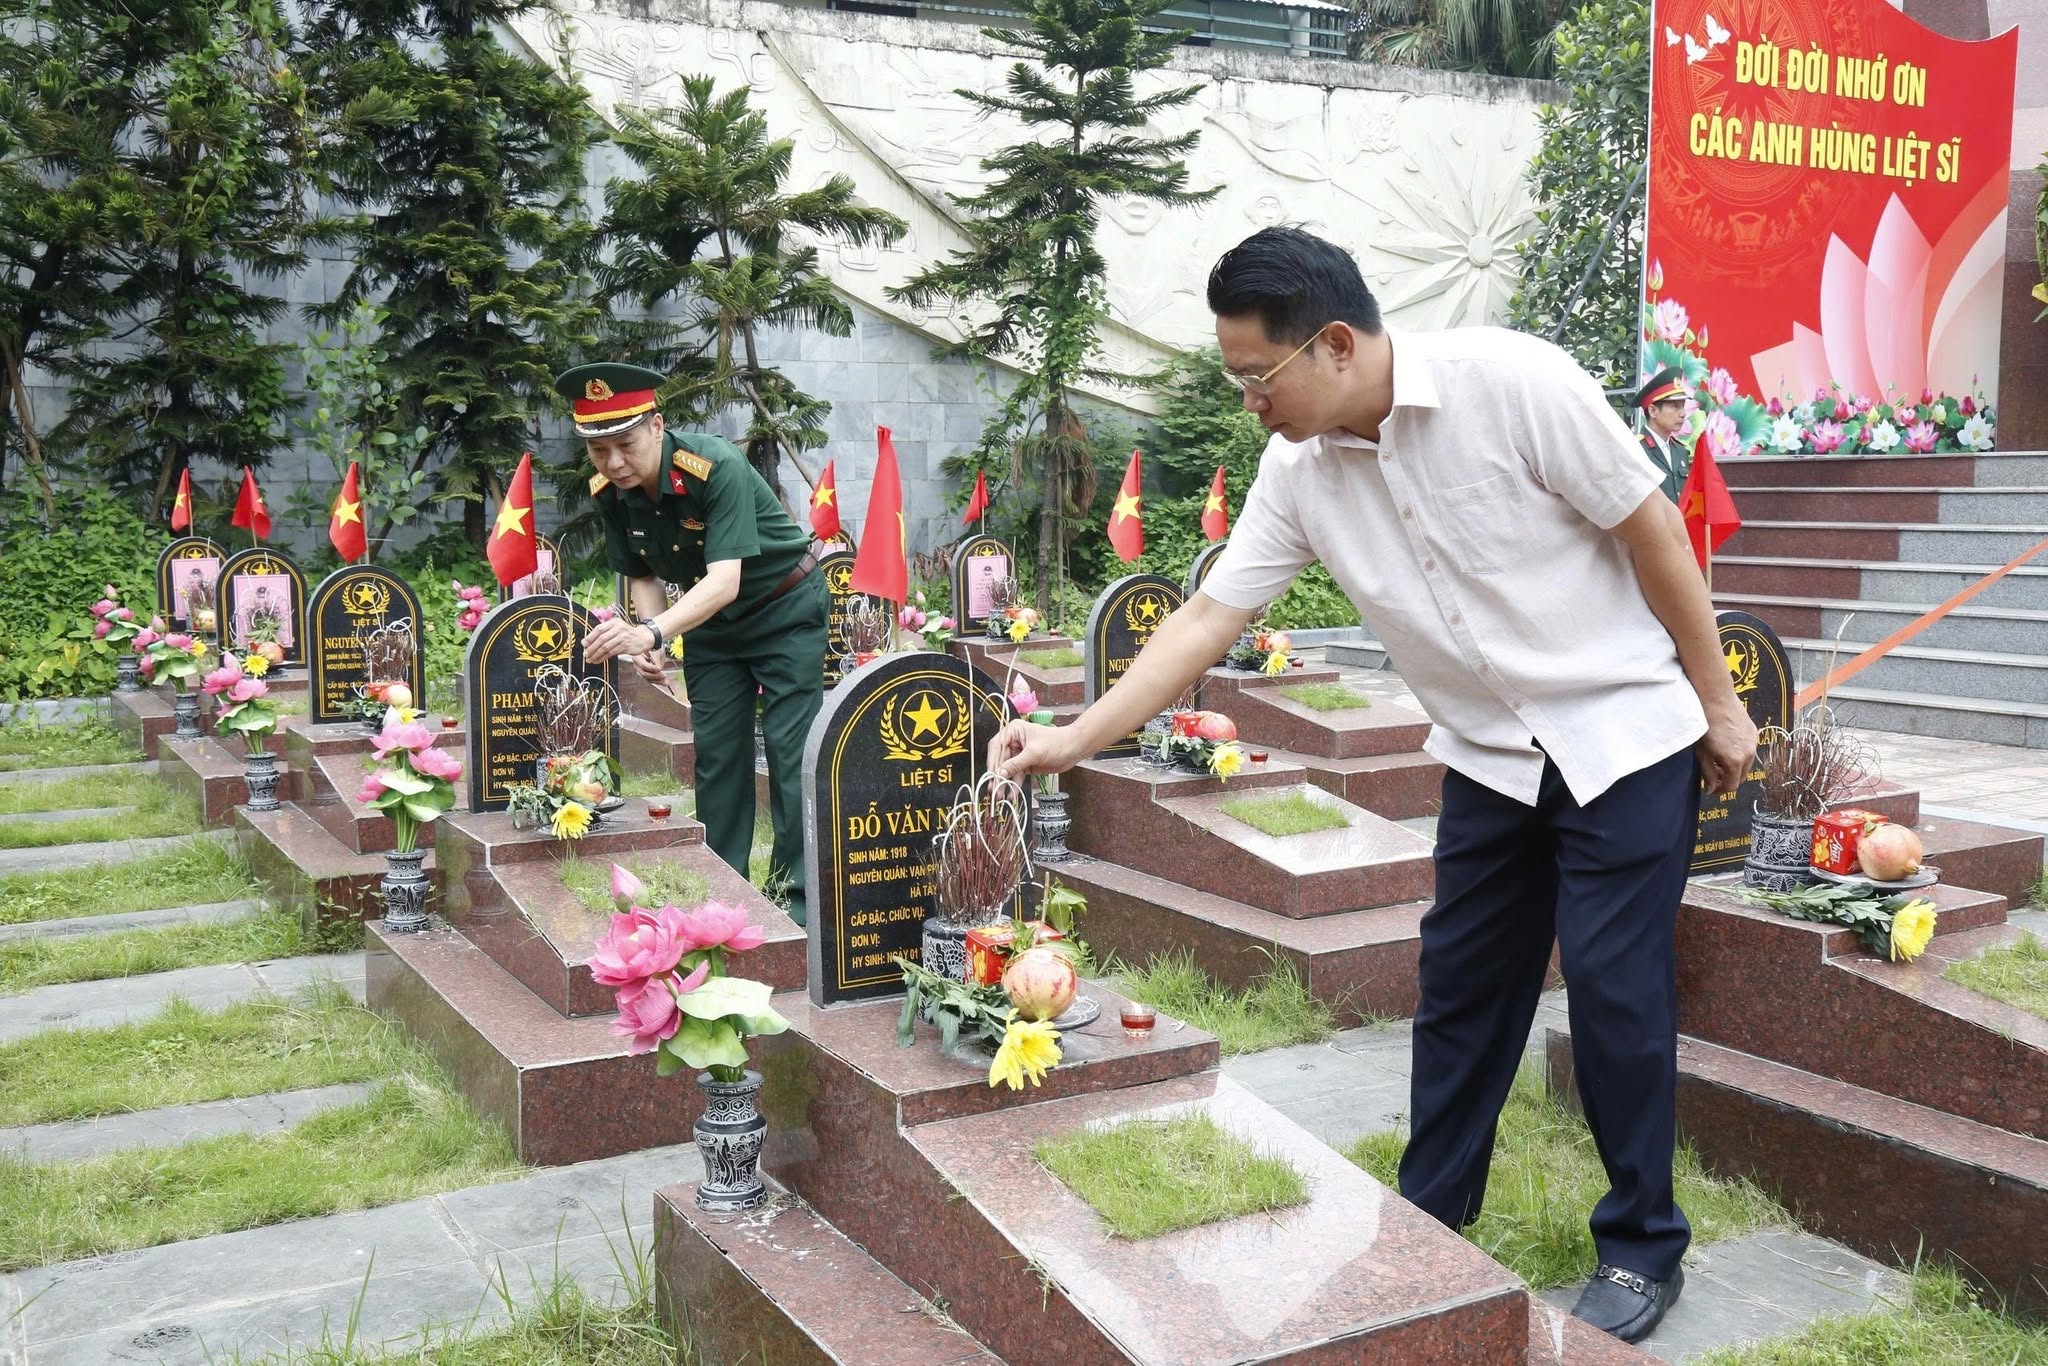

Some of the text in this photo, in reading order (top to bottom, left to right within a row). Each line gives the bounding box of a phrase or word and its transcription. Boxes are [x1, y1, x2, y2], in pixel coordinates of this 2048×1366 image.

[1736, 34, 1926, 107] ĐỜI ĐỜI NHỚ ƠN
[1690, 107, 1962, 187] CÁC ANH HÙNG LIỆT SĨ
[492, 692, 535, 712] PHẠM
[492, 715, 507, 724] SINH
[492, 727, 518, 737] NGUYÊN
[492, 752, 506, 763] CẤP
[493, 767, 506, 777] ĐƠN
[901, 764, 953, 789] LIỆT SĨ
[848, 800, 882, 840] ĐỖ
[886, 803, 931, 836] VĂN
[849, 846, 908, 864] SINH NĂM: 1918
[849, 870, 882, 885] NGUYÊN
[883, 865, 908, 881] QUÁN:
[910, 882, 921, 898] HÀ
[850, 905, 925, 927] CẤP BẬC, CHỨC VỤ:
[851, 933, 880, 948] ĐƠN VỊ:
[852, 956, 864, 969] HY
[865, 954, 886, 967] SINH:
